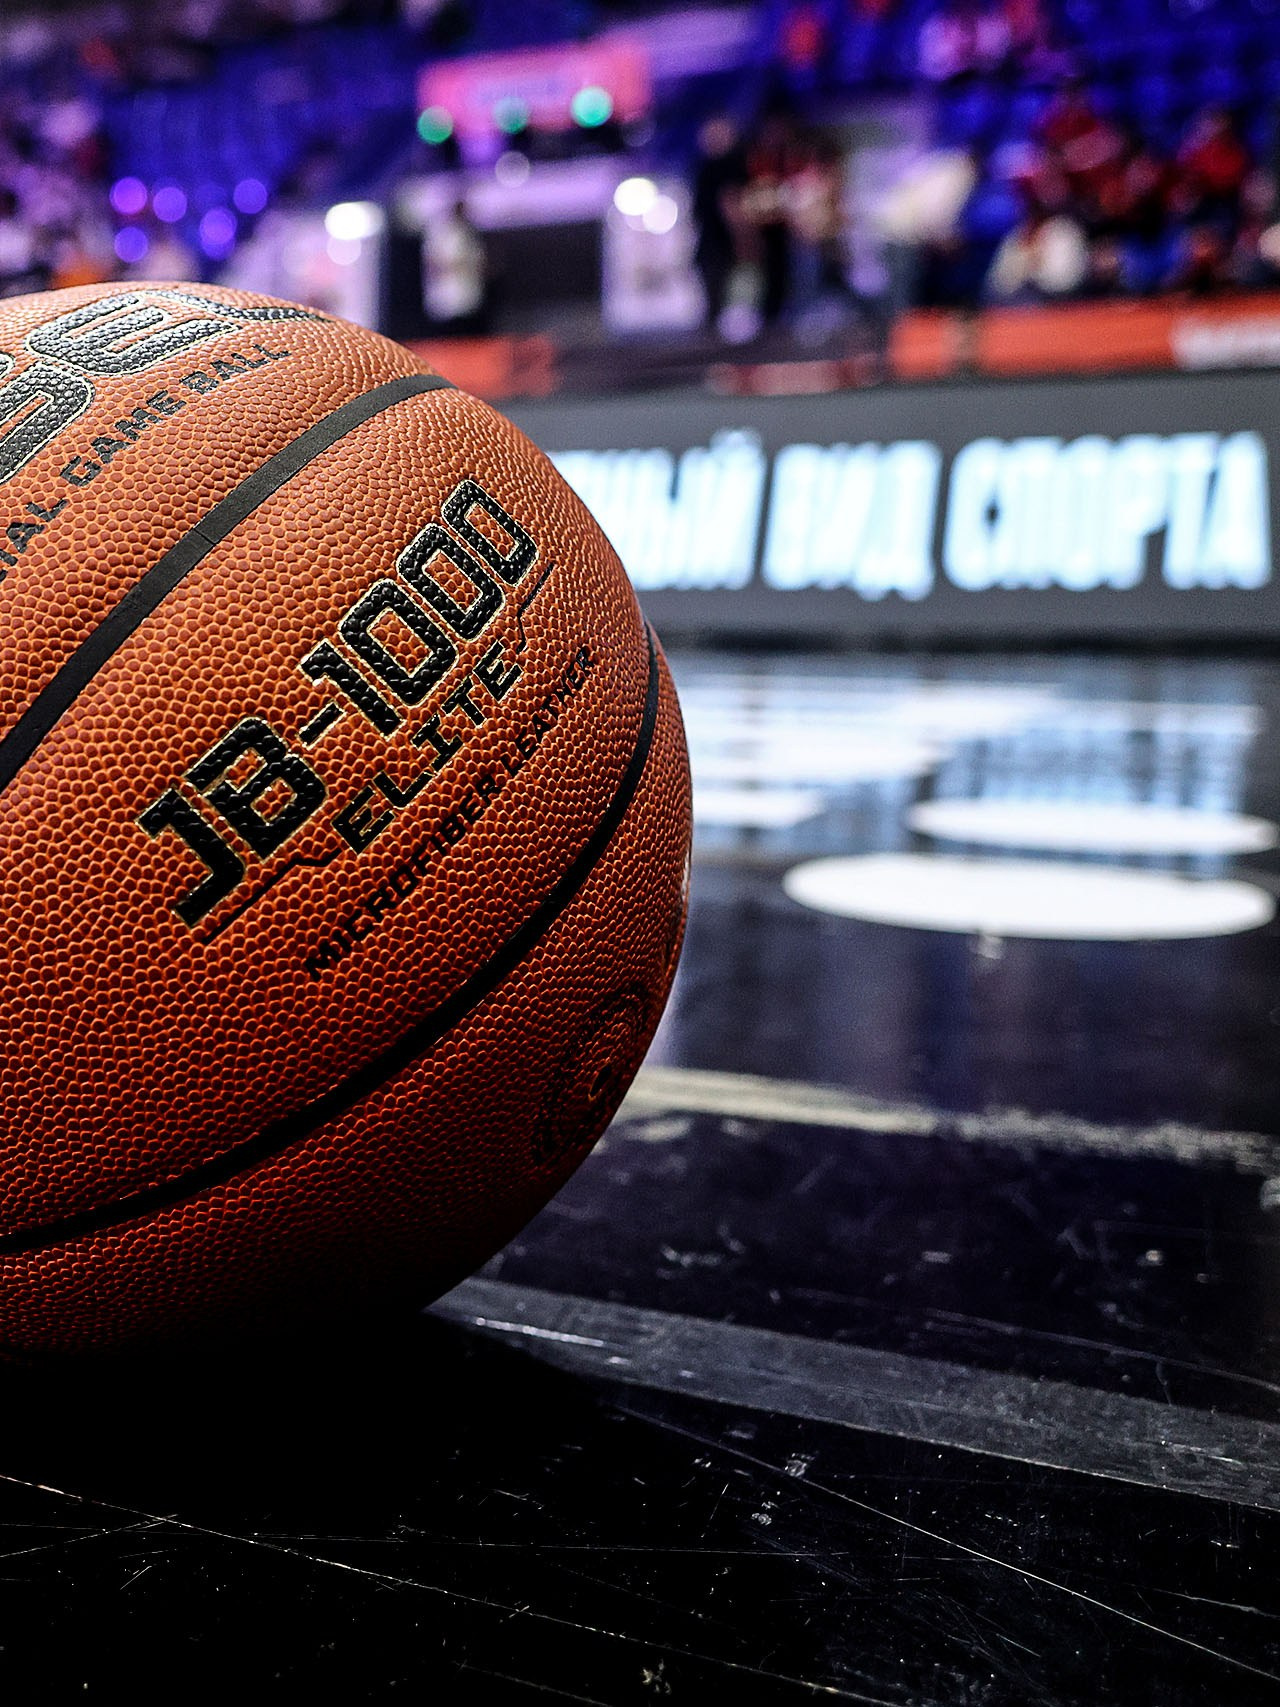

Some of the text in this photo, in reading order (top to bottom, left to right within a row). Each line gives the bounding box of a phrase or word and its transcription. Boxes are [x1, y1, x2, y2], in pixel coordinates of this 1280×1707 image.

[60, 389, 187, 487] GAME
[179, 344, 292, 395] BALL
[763, 440, 942, 600] ВИД
[944, 431, 1269, 592] СПОРТА
[134, 479, 540, 929] JB-1000
[330, 639, 524, 855] ELITE
[304, 645, 594, 981] MICROFIBER LEATHER
